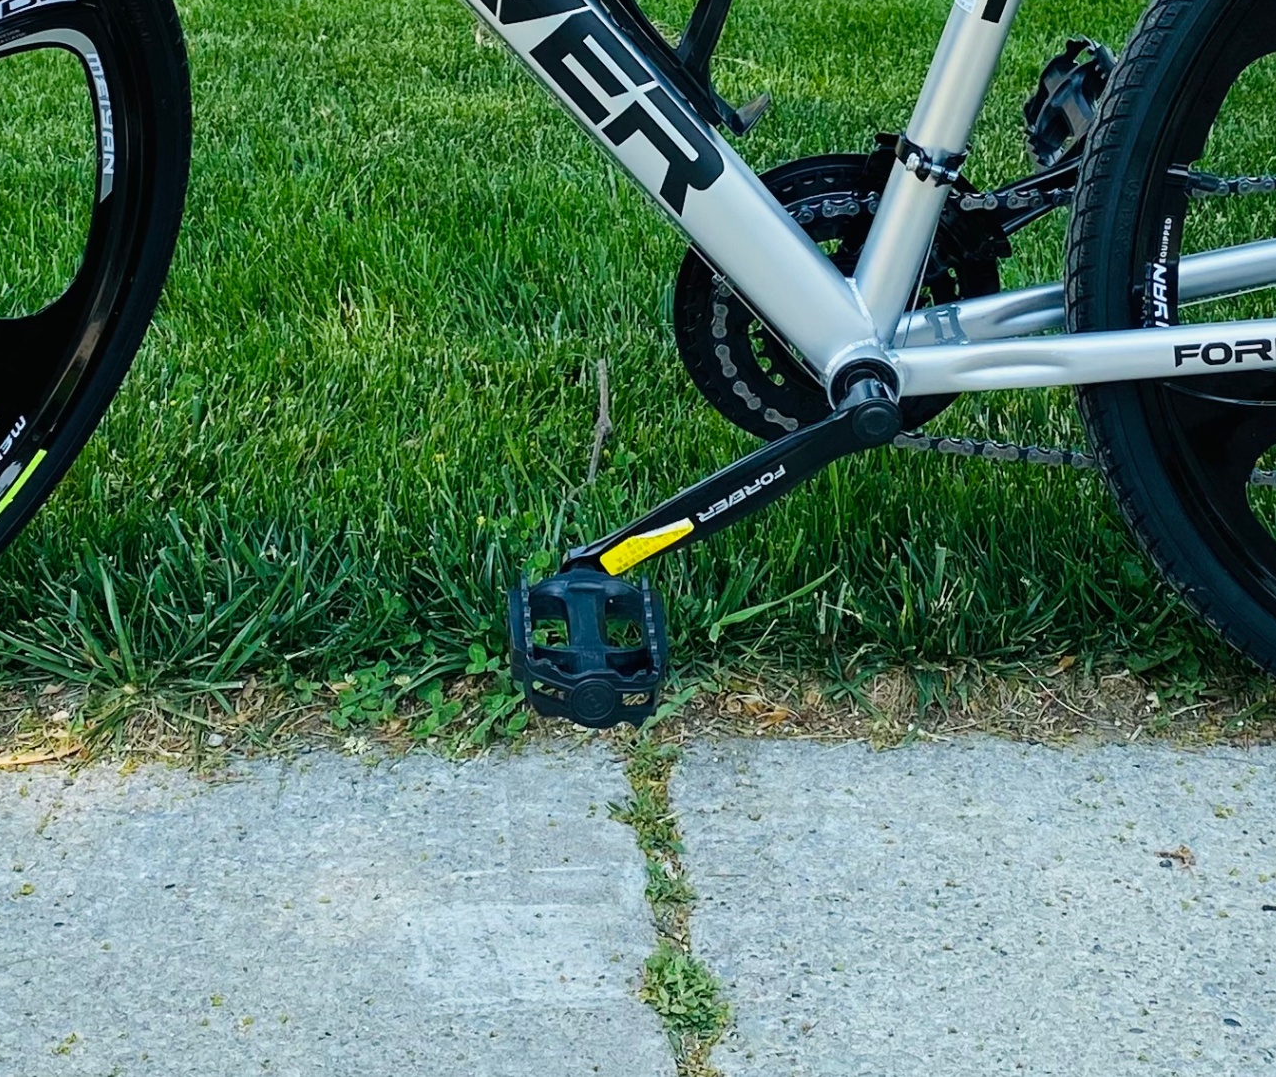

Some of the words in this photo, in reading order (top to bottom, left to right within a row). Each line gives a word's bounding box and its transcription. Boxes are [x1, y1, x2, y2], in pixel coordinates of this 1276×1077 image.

[1159, 217, 1172, 263] EQUIPPED
[1153, 263, 1169, 319] YAN
[696, 464, 786, 523] FOREVER
